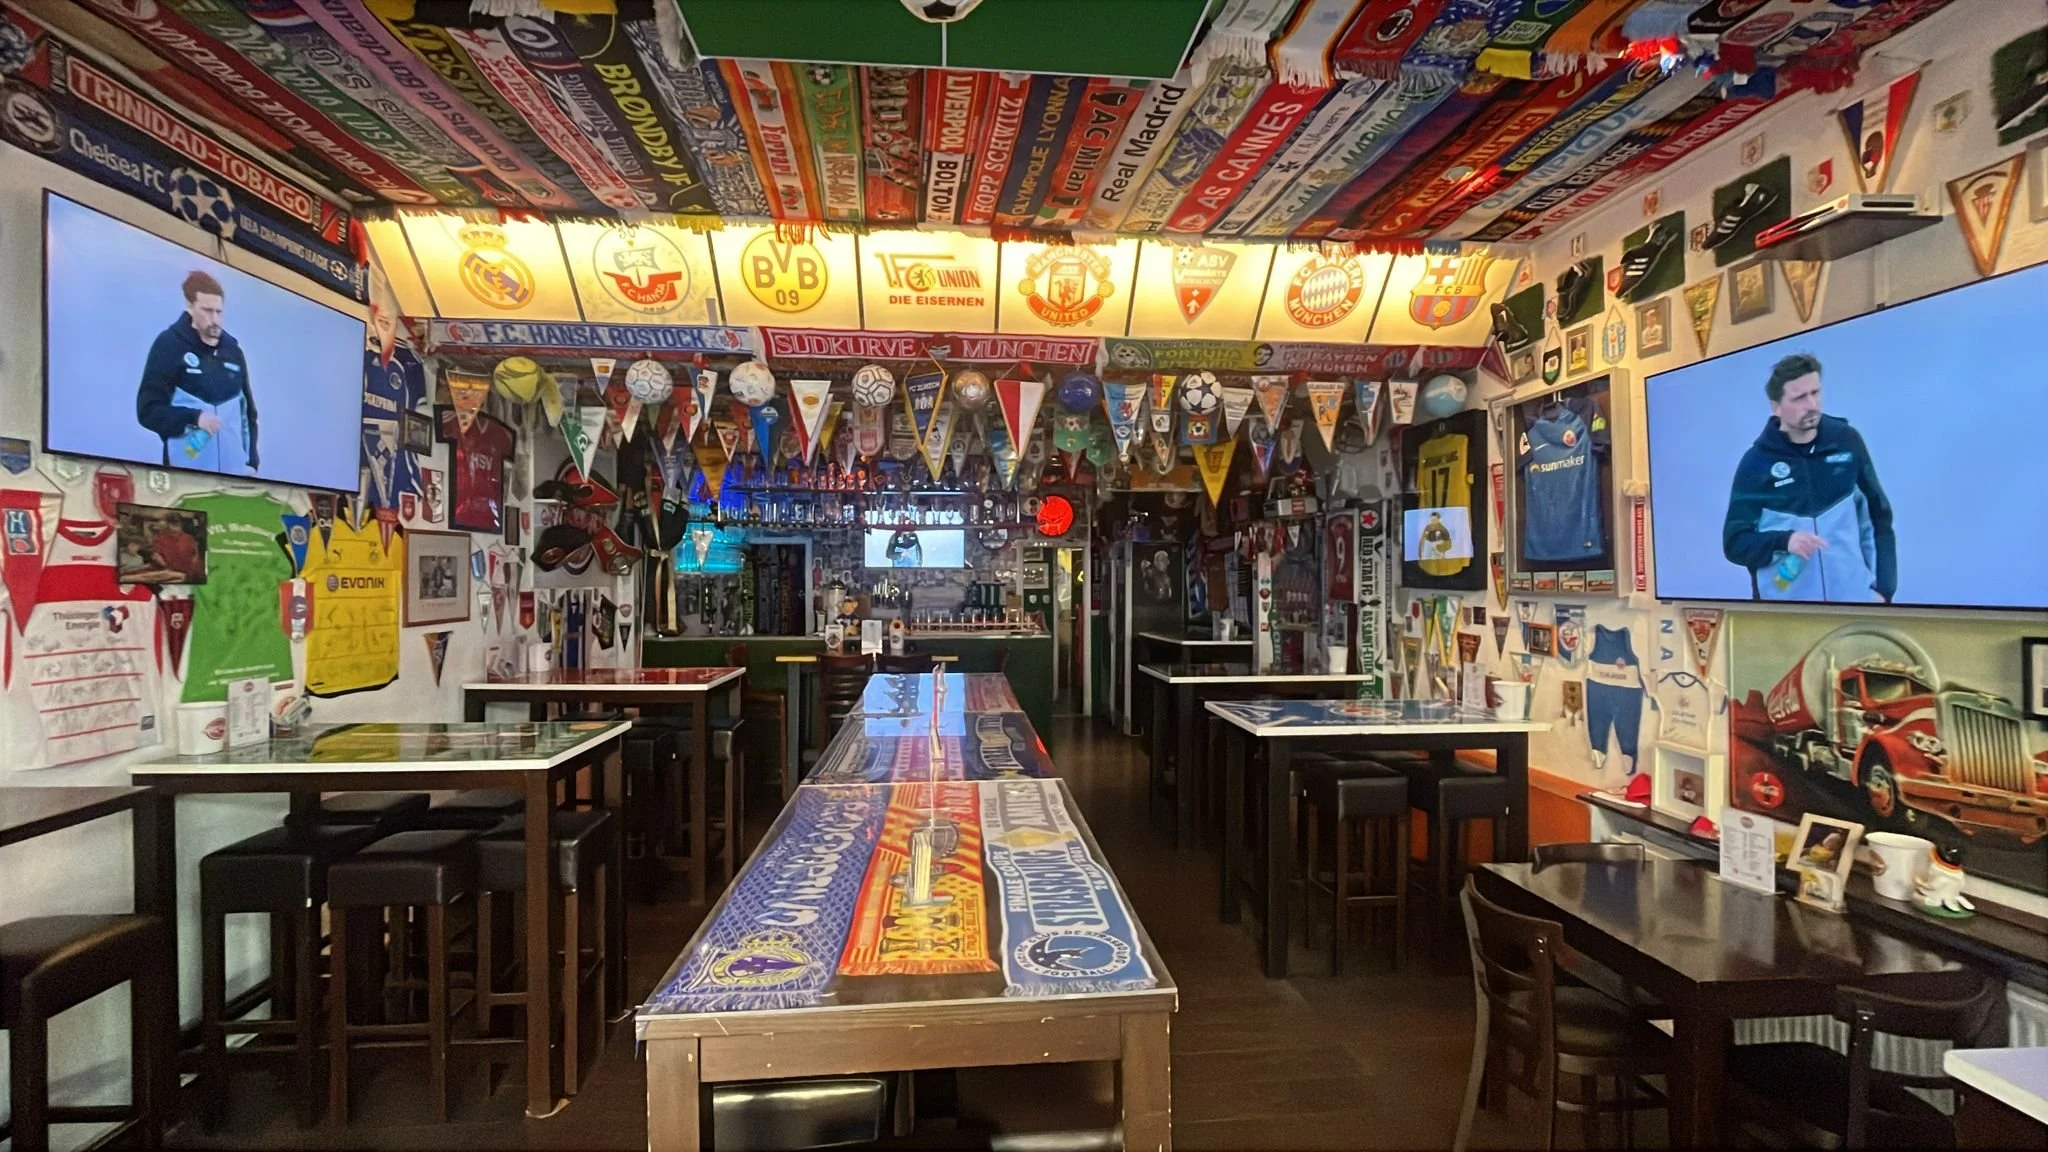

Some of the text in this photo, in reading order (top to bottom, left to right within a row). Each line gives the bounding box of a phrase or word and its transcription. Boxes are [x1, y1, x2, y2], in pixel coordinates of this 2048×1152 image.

[418, 85, 453, 118] de
[940, 75, 973, 153] LIVERPOOL
[71, 60, 312, 220] TRINIDAD-TOBAGO
[594, 62, 692, 188] BRØNDBY IF
[1101, 160, 1138, 203] Real
[1124, 84, 1187, 157] Madrid
[69, 127, 166, 194] Chelsea FC
[761, 125, 793, 177] Ferrari
[1013, 76, 1073, 216] OLYMPIQUE LYONNA
[1067, 108, 1117, 193] AC Milan
[1198, 184, 1229, 210] AS
[1221, 100, 1303, 182] CANNES
[1481, 102, 1647, 210] OLYMPIQUE
[1570, 141, 1649, 185] BRUGGE
[933, 160, 958, 213] BOLTON
[974, 175, 1000, 217] HOPP
[752, 239, 820, 290] BVB
[936, 268, 982, 289] UNION
[1196, 255, 1231, 268] ASV
[1294, 254, 1363, 287] FC BAYERN
[636, 283, 666, 302] HANSA
[775, 289, 800, 307] 09
[889, 295, 985, 307] DIE EISERNEN
[1040, 302, 1089, 323] UNITED
[1287, 299, 1354, 326] MÜNCHEN
[531, 323, 602, 346] HANSA
[609, 325, 706, 349] ROSTOCK
[774, 333, 1089, 362] SÜDKURVE MÜNCHEN
[1154, 347, 1240, 359] FORTUNA
[1312, 351, 1378, 362] BAYERN
[1540, 453, 1585, 473] sunmaker
[1431, 467, 1451, 508] 17
[341, 577, 385, 589] EVONIK
[1361, 537, 1374, 596] RED STAR FC
[1362, 610, 1374, 623] AS
[1004, 782, 1048, 827] AMIENS
[993, 849, 1028, 912] FINALE COUPE
[1013, 849, 1105, 927] STRASBOURG
[1093, 879, 1108, 889] 26
